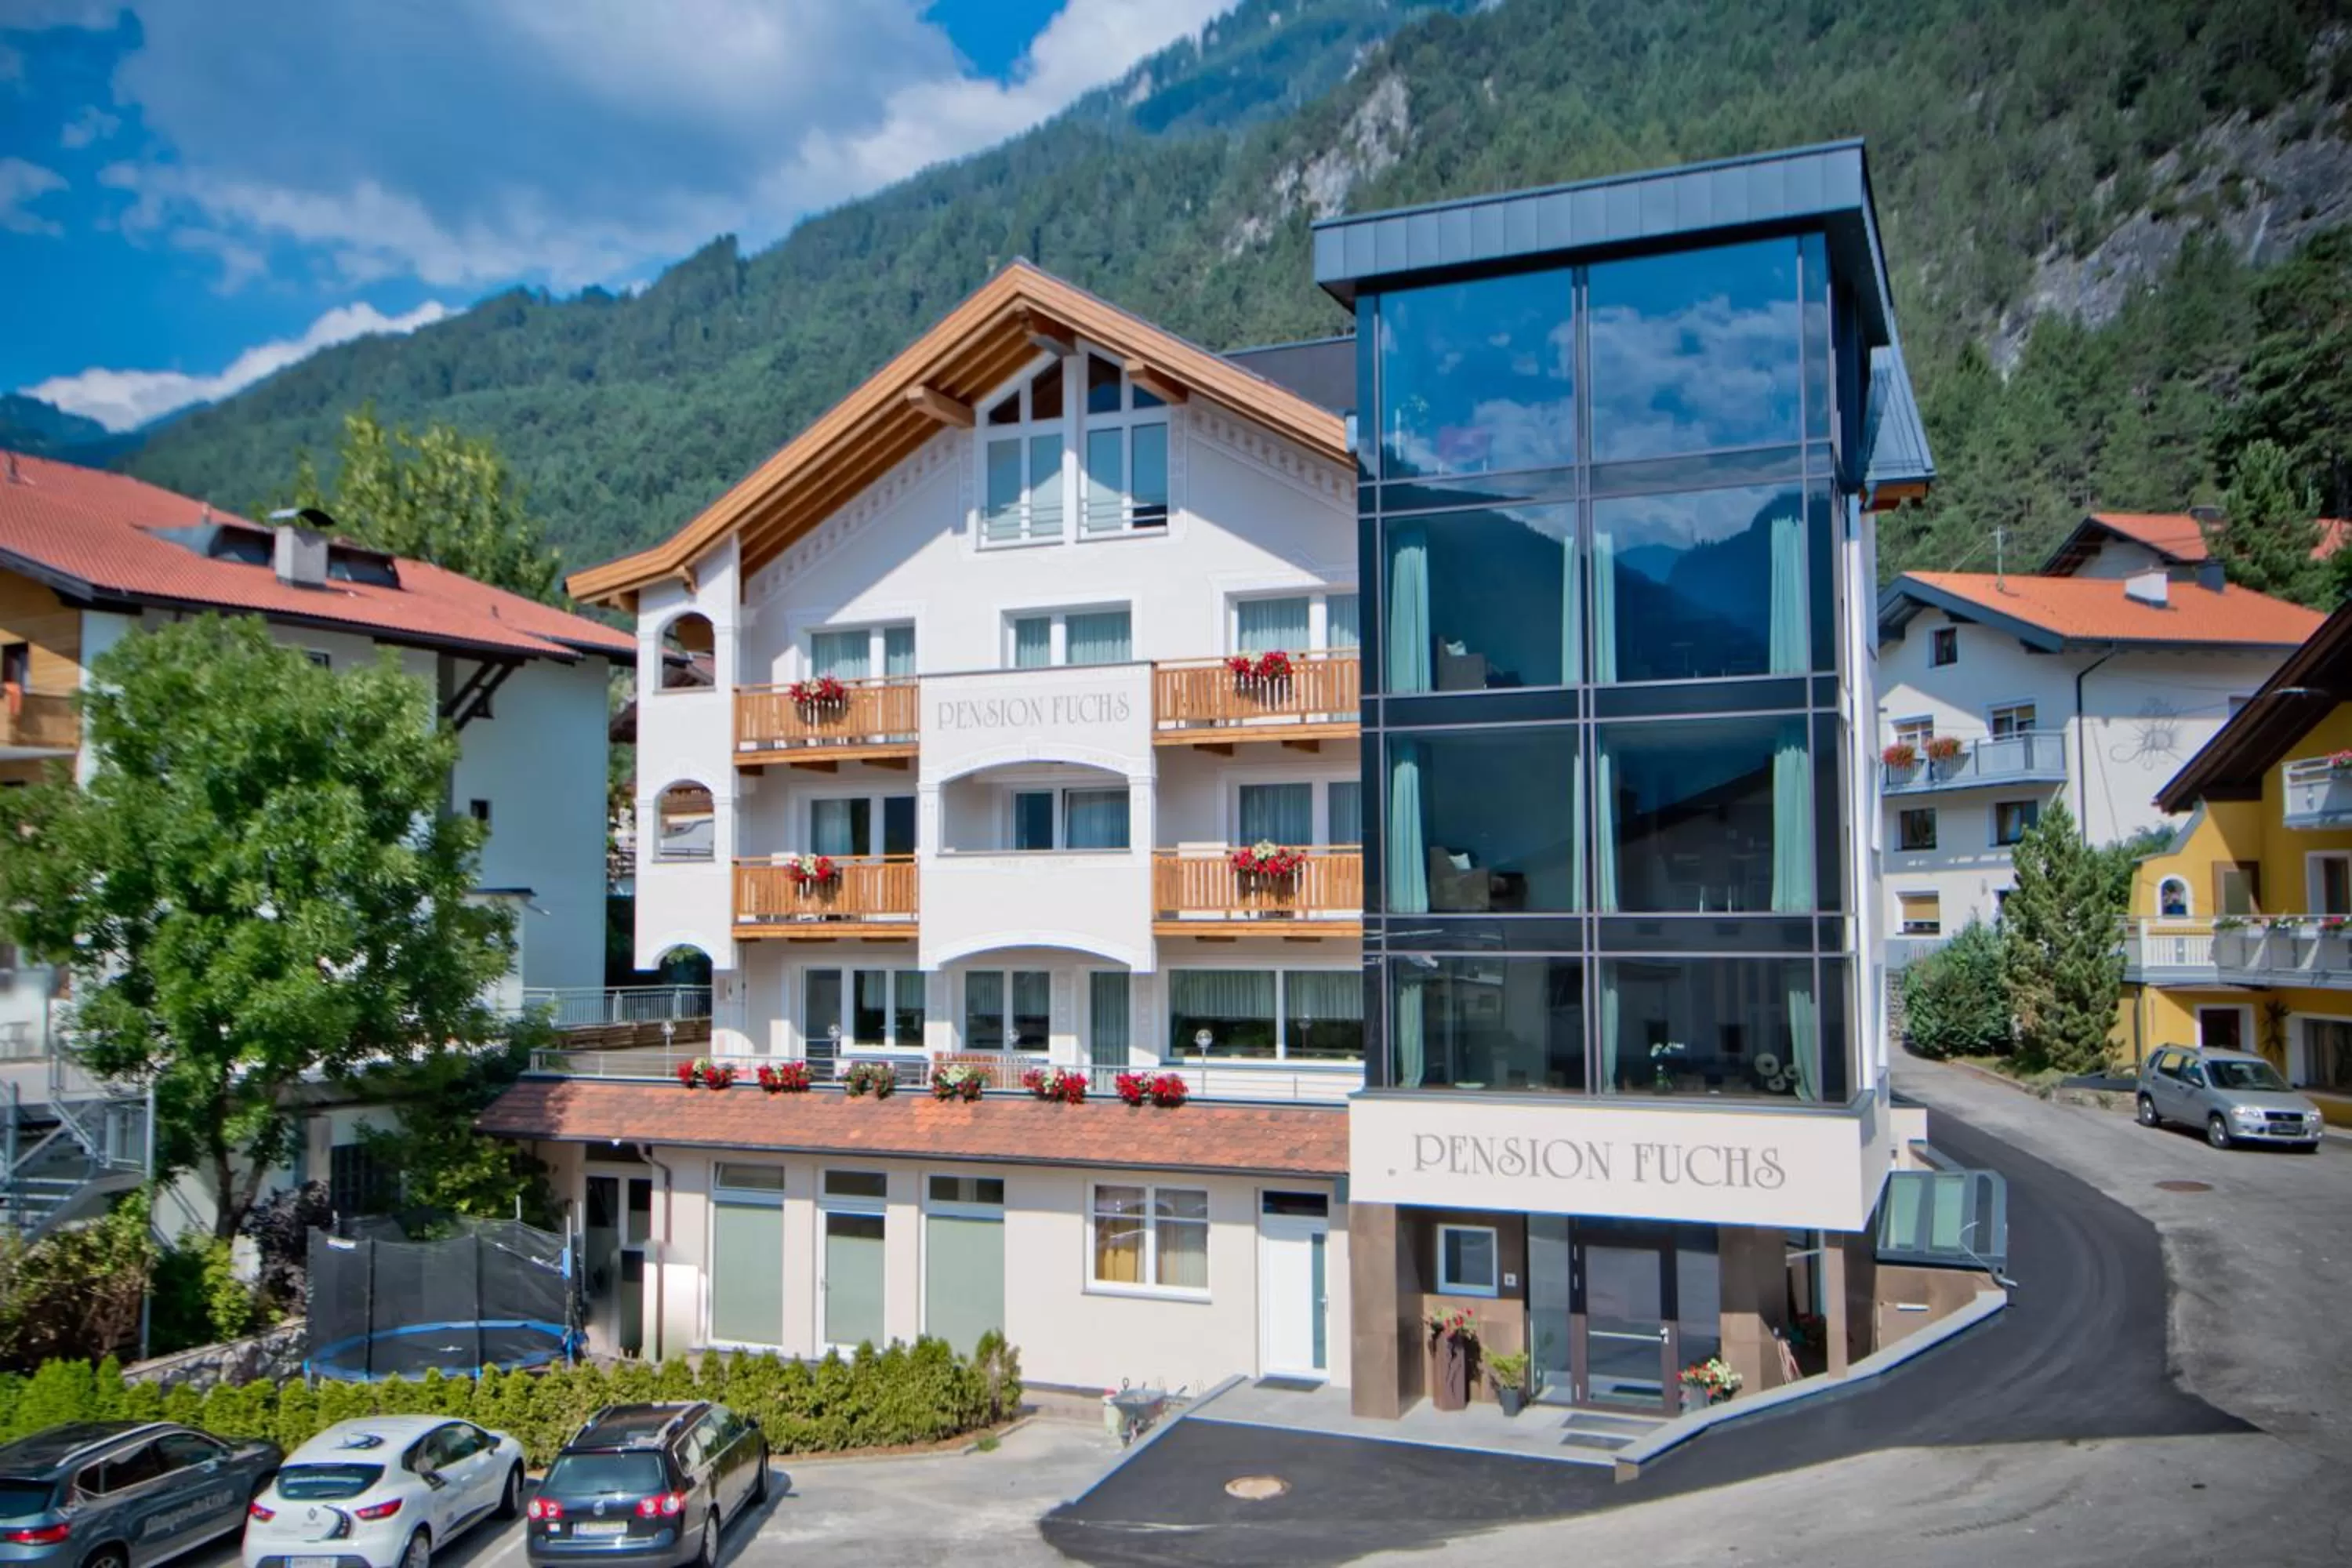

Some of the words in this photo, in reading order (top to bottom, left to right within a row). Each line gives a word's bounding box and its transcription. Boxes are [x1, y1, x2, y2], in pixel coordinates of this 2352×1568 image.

[937, 696, 1044, 730] PENSION
[1051, 692, 1130, 726] FUCHS
[1413, 1132, 1613, 1181] PENSION
[1631, 1142, 1787, 1190] FUCHS
